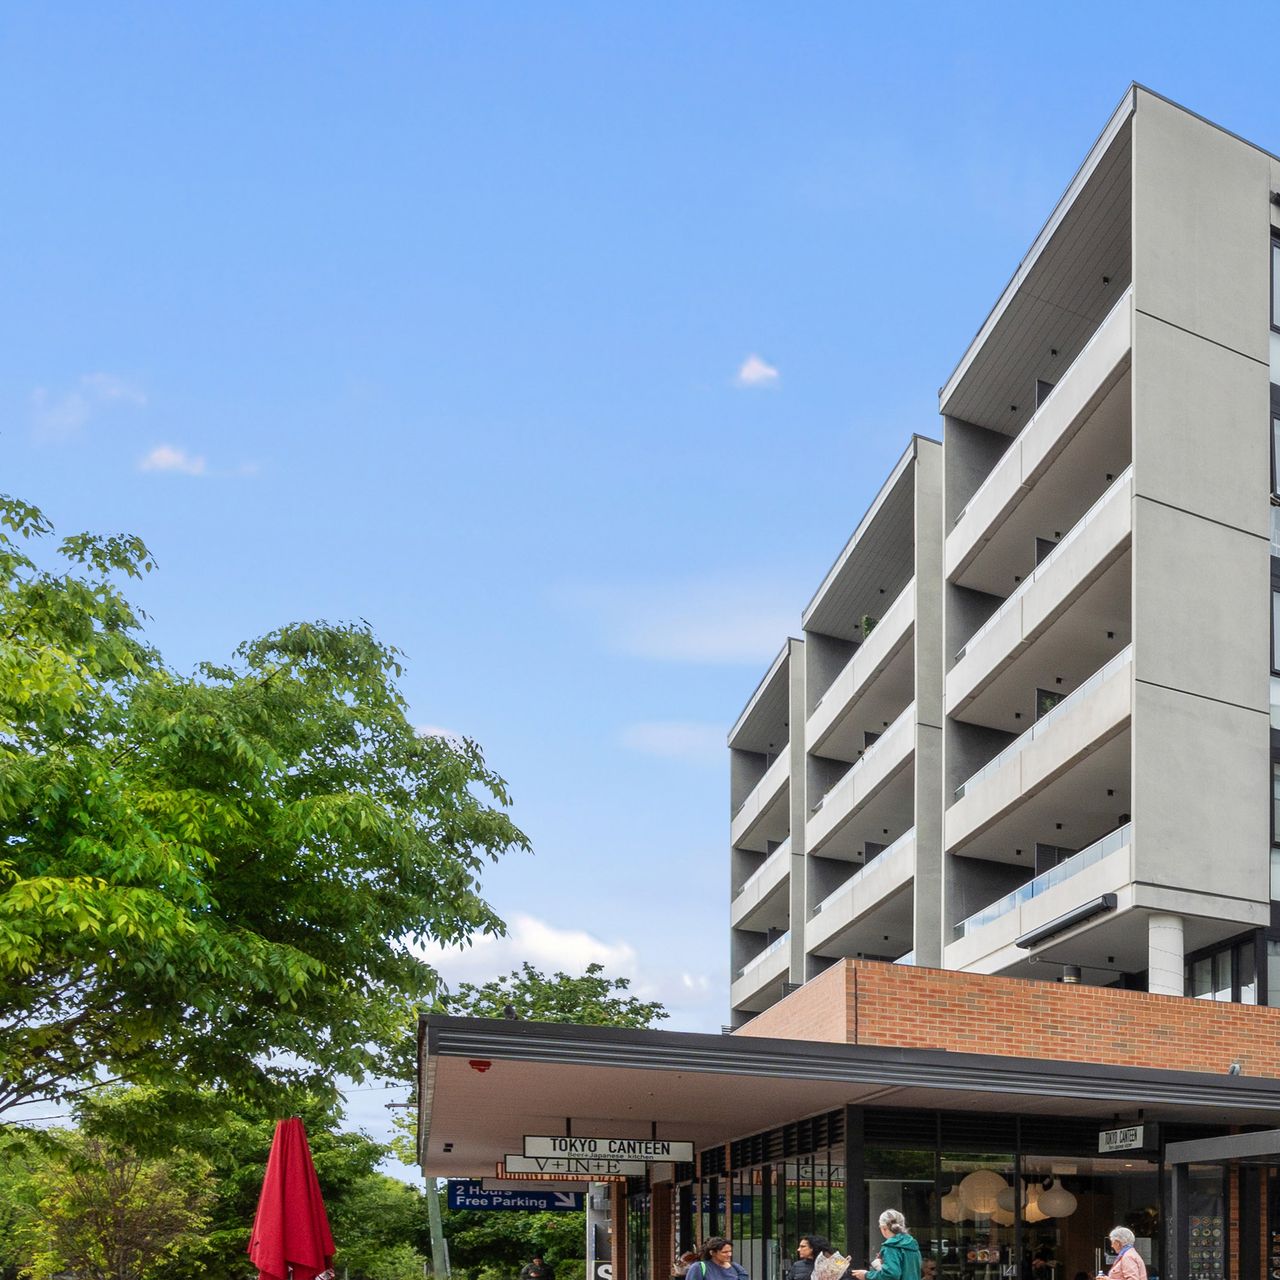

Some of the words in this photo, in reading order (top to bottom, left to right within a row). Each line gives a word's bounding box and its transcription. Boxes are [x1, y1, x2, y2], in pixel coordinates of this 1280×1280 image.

[551, 1138, 597, 1152] TOKYO
[608, 1140, 671, 1155] CANTEEN
[456, 1185, 464, 1195] 2
[456, 1196, 488, 1206] Free
[493, 1196, 547, 1209] Parking
